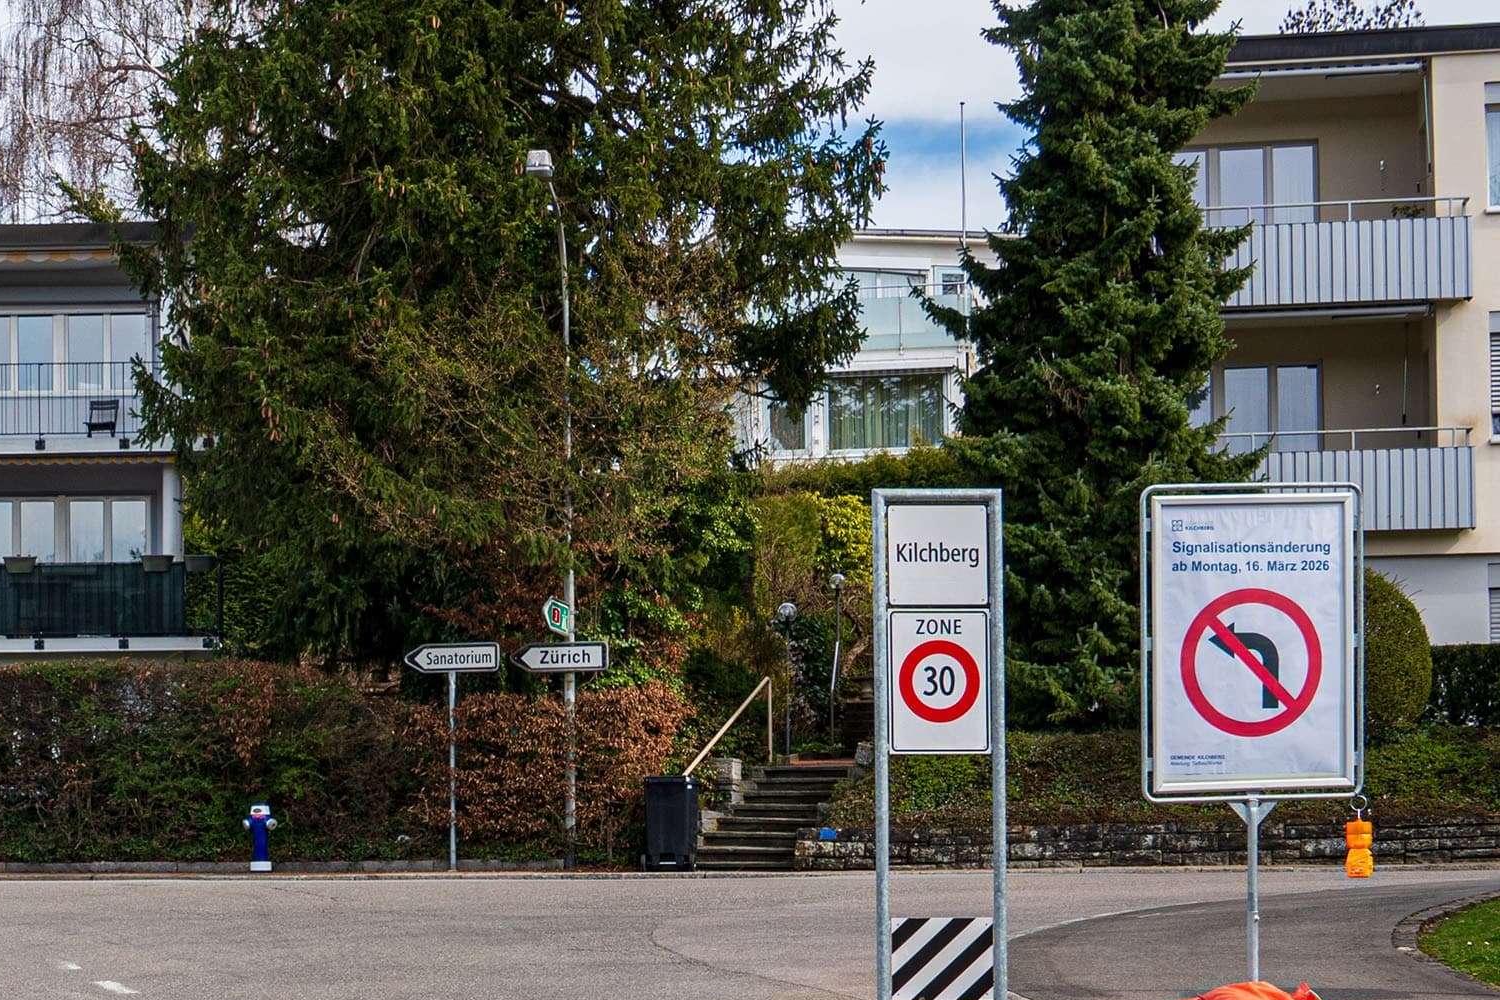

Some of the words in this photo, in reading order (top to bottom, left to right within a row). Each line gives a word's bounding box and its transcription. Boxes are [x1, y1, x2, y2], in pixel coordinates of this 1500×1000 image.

[896, 542, 980, 567] Kilchberg
[1172, 541, 1330, 556] Signalisationsänderung
[1172, 560, 1188, 572] ab
[1192, 561, 1242, 574] Montag,
[1245, 561, 1263, 572] 16.
[1267, 561, 1297, 571] März
[1300, 560, 1329, 571] 2026
[916, 619, 962, 634] ZONE
[426, 650, 492, 665] Sanatorium
[540, 650, 591, 664] Zürich
[923, 665, 956, 697] 30
